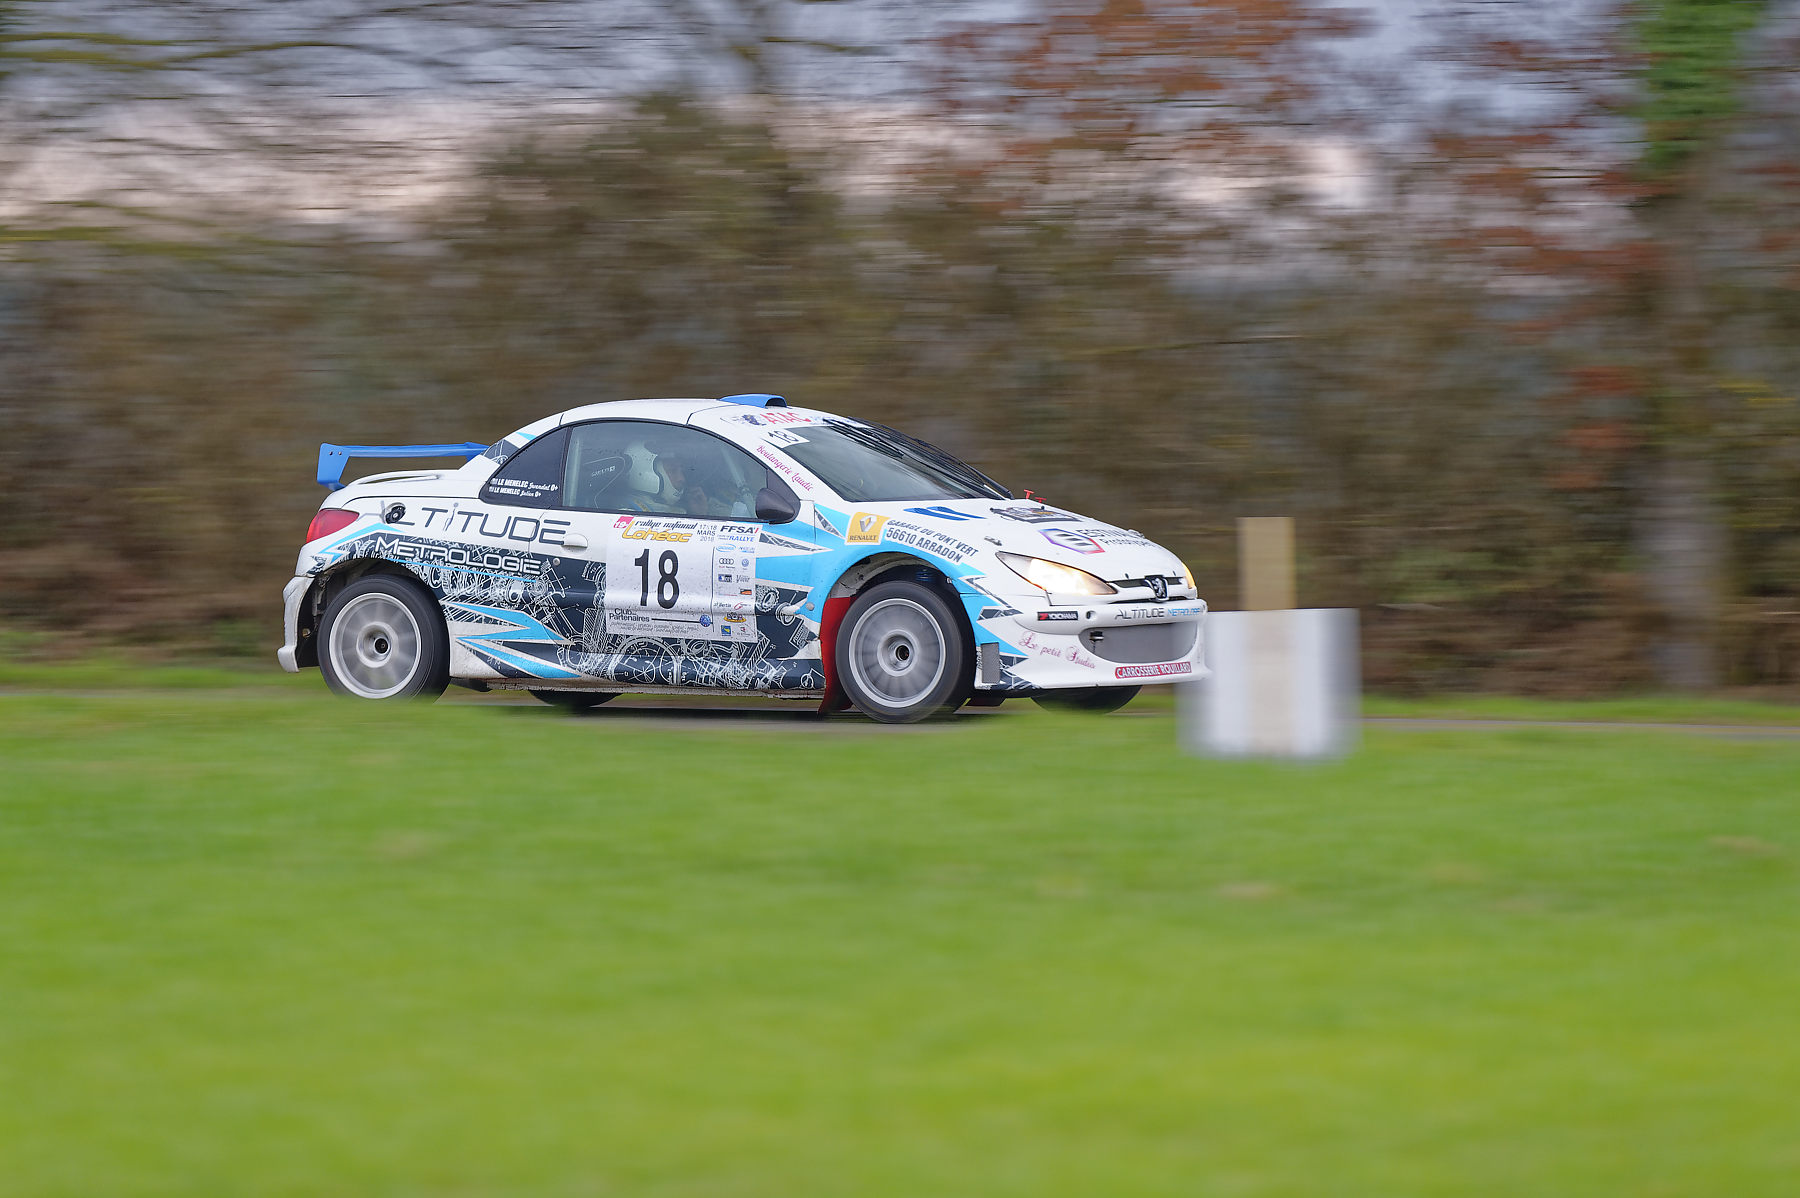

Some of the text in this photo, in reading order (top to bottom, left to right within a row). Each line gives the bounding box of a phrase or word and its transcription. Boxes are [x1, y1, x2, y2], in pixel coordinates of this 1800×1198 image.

[767, 430, 799, 444] 18
[497, 478, 504, 486] LE
[622, 520, 692, 542] Lohéac
[634, 520, 661, 529] rallye
[663, 521, 698, 531] national
[720, 525, 754, 534] FFSA
[886, 527, 963, 563] 56610 ARRADON
[887, 519, 979, 557] GARAGE DU PONT VERT
[375, 536, 542, 576] METROLOGIE
[634, 548, 679, 609] 18
[609, 613, 650, 622] Partenaires
[1040, 647, 1061, 658] petit
[1116, 662, 1191, 678] CARROSSERIE ROUILLARD
